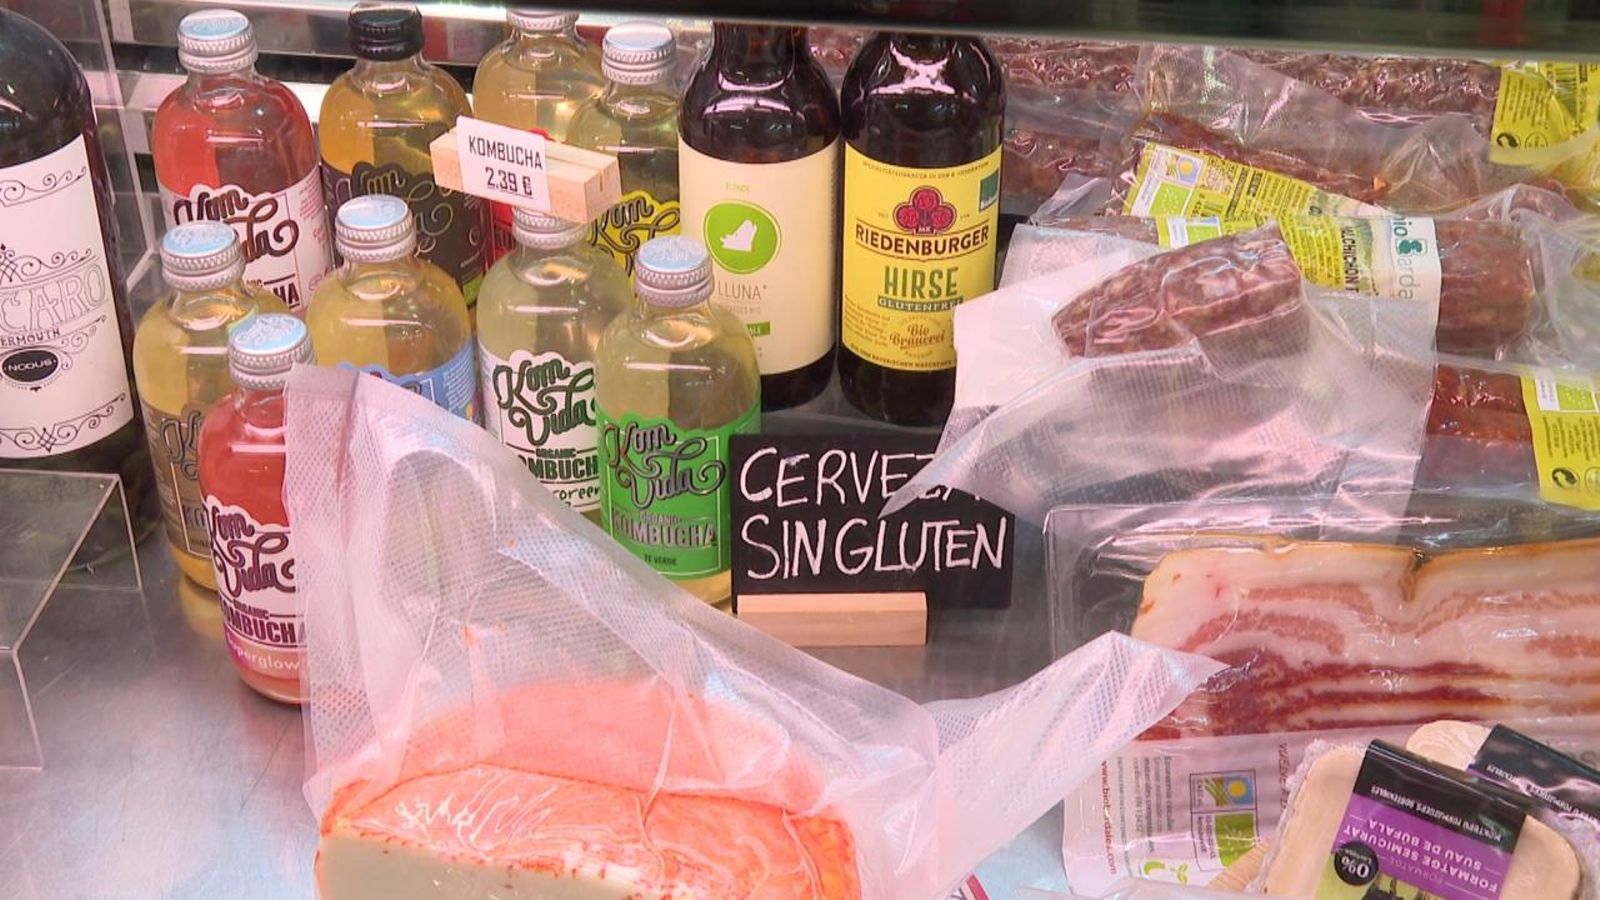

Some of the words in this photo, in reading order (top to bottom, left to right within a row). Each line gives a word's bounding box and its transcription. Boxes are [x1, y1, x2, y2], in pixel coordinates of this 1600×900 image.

[468, 135, 543, 170] KOMBUCHA
[856, 223, 989, 256] RIEDENBURGER
[884, 265, 960, 300] HIRSE
[890, 328, 946, 348] Brauerei
[907, 323, 930, 337] Bio
[492, 359, 571, 416] Kom
[508, 367, 597, 447] Vida
[517, 455, 599, 480] MBUCH
[604, 421, 677, 480] Kom
[616, 437, 728, 511] Vida
[740, 447, 982, 507] CERVE
[612, 507, 717, 549] KOMBUCHA
[1342, 820, 1421, 863] SEMICURAT
[1421, 839, 1442, 855] DE
[1337, 854, 1371, 879] 0%
[1420, 852, 1498, 894] FORMATGE
[1442, 847, 1483, 872] SUAU
